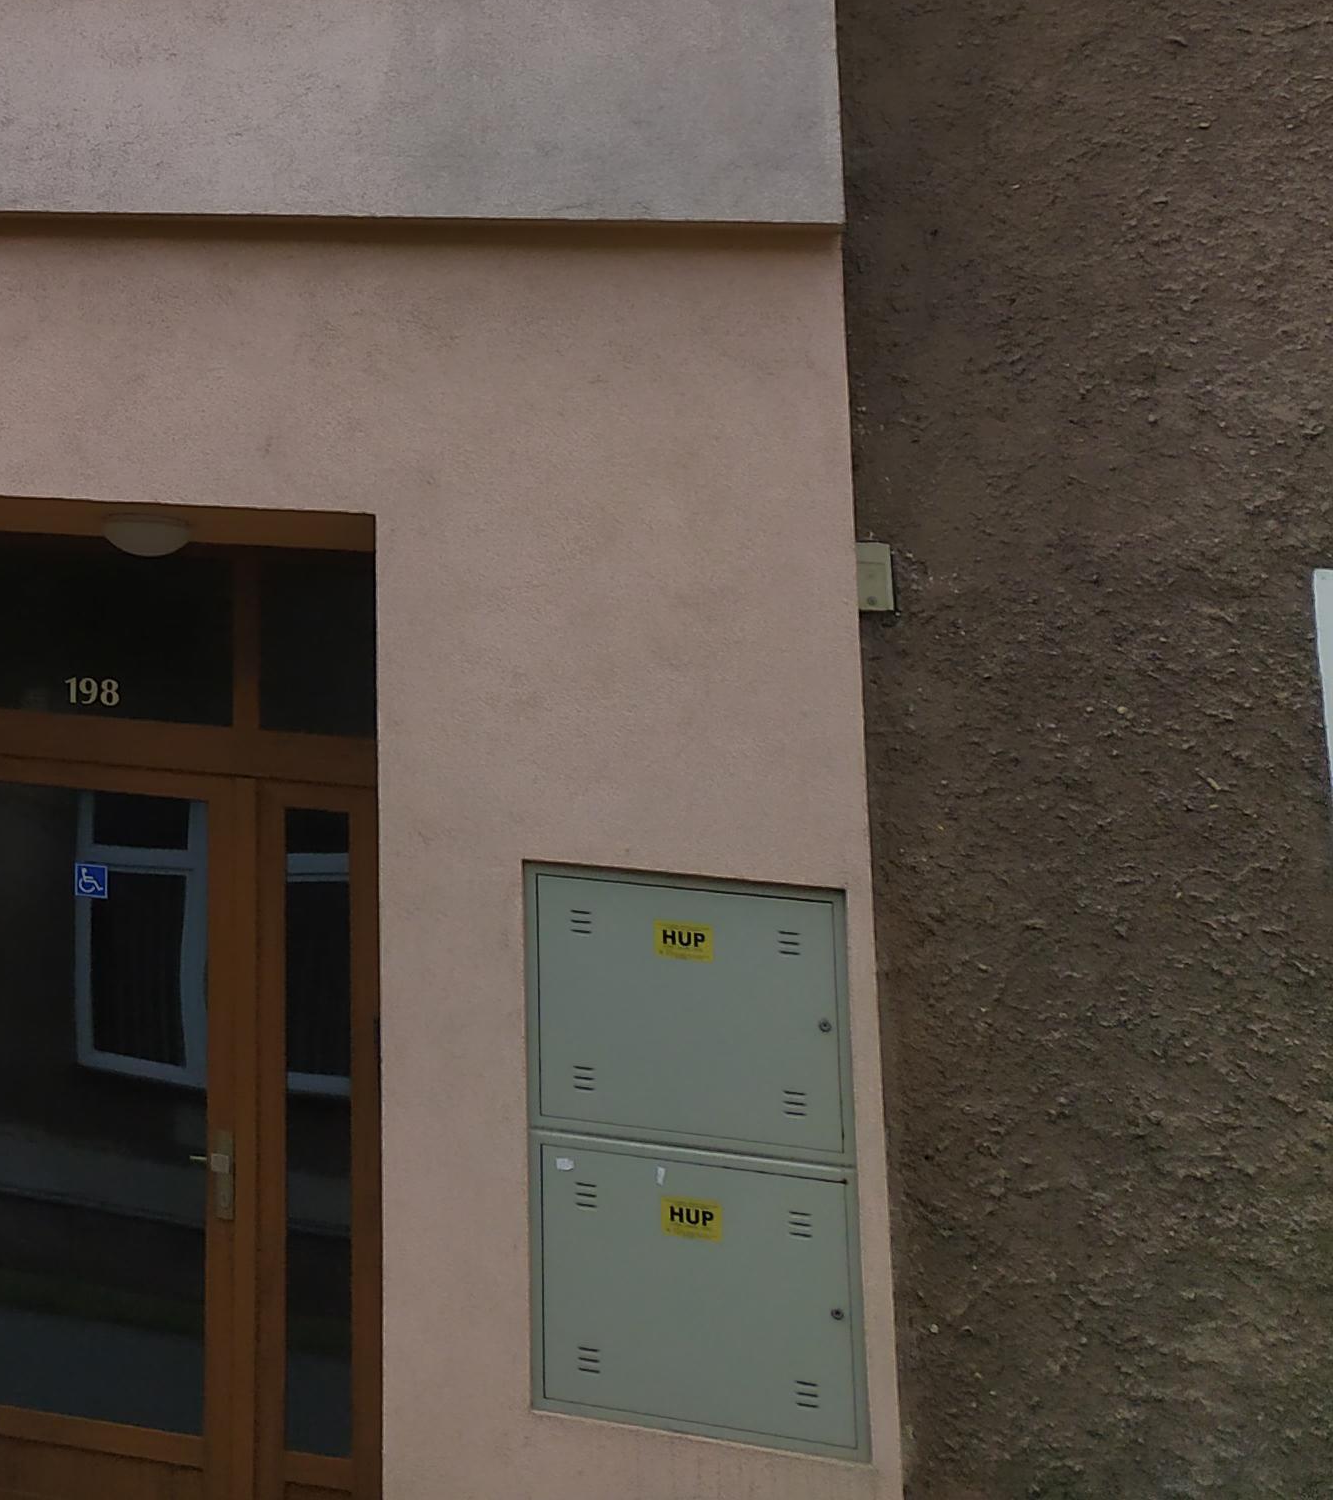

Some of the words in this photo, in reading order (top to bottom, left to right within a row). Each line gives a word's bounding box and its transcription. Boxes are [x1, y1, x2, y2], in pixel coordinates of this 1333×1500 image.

[64, 676, 120, 706] 198
[662, 929, 706, 948] HUP
[669, 1205, 714, 1227] HUP
